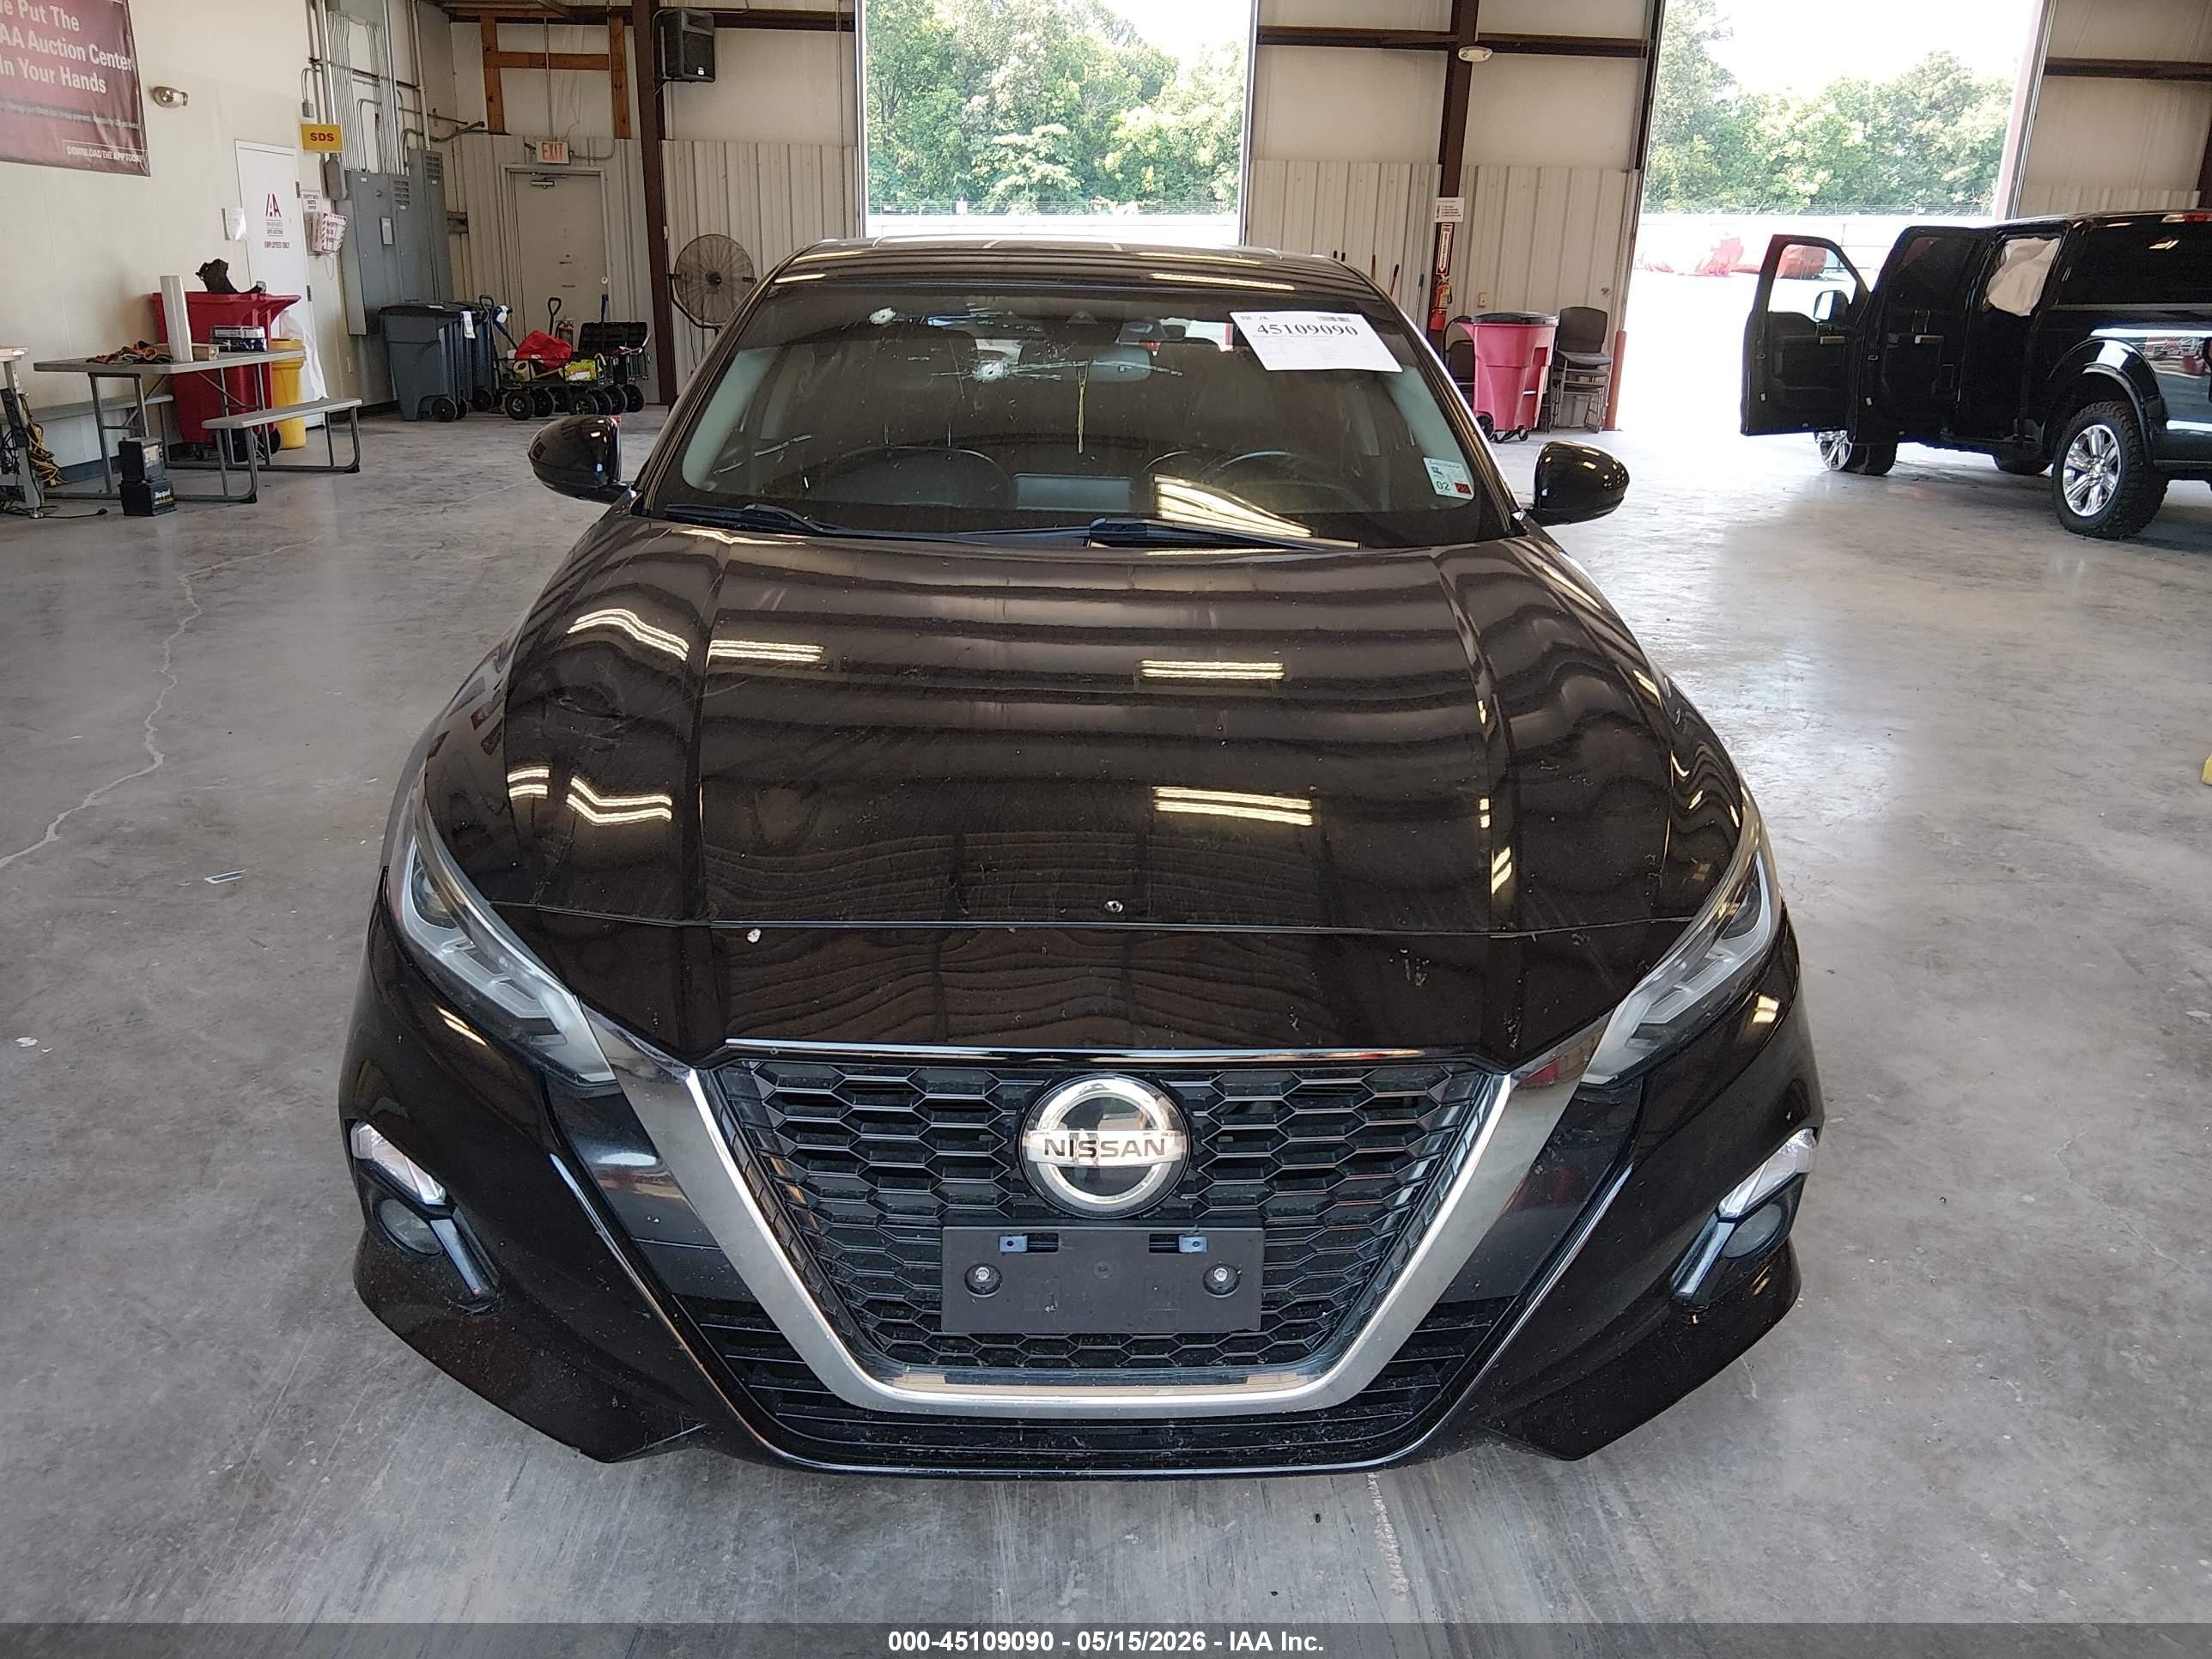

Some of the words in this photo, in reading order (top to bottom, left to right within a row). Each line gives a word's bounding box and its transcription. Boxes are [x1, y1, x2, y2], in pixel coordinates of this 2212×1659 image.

[0, 0, 14, 15] e
[18, 0, 47, 24] Put
[50, 5, 80, 32] The
[28, 30, 86, 61] Auction
[88, 43, 132, 71] Center
[17, 57, 55, 84] Your
[59, 65, 106, 94] Hands
[310, 132, 335, 142] SDS
[67, 146, 102, 158] DOWNLOAD
[102, 151, 113, 160] THE
[542, 142, 563, 161] EXIT
[1257, 324, 1358, 337] 45109090
[1437, 481, 1451, 491] 02
[1044, 1139, 1165, 1158] NISSAN
